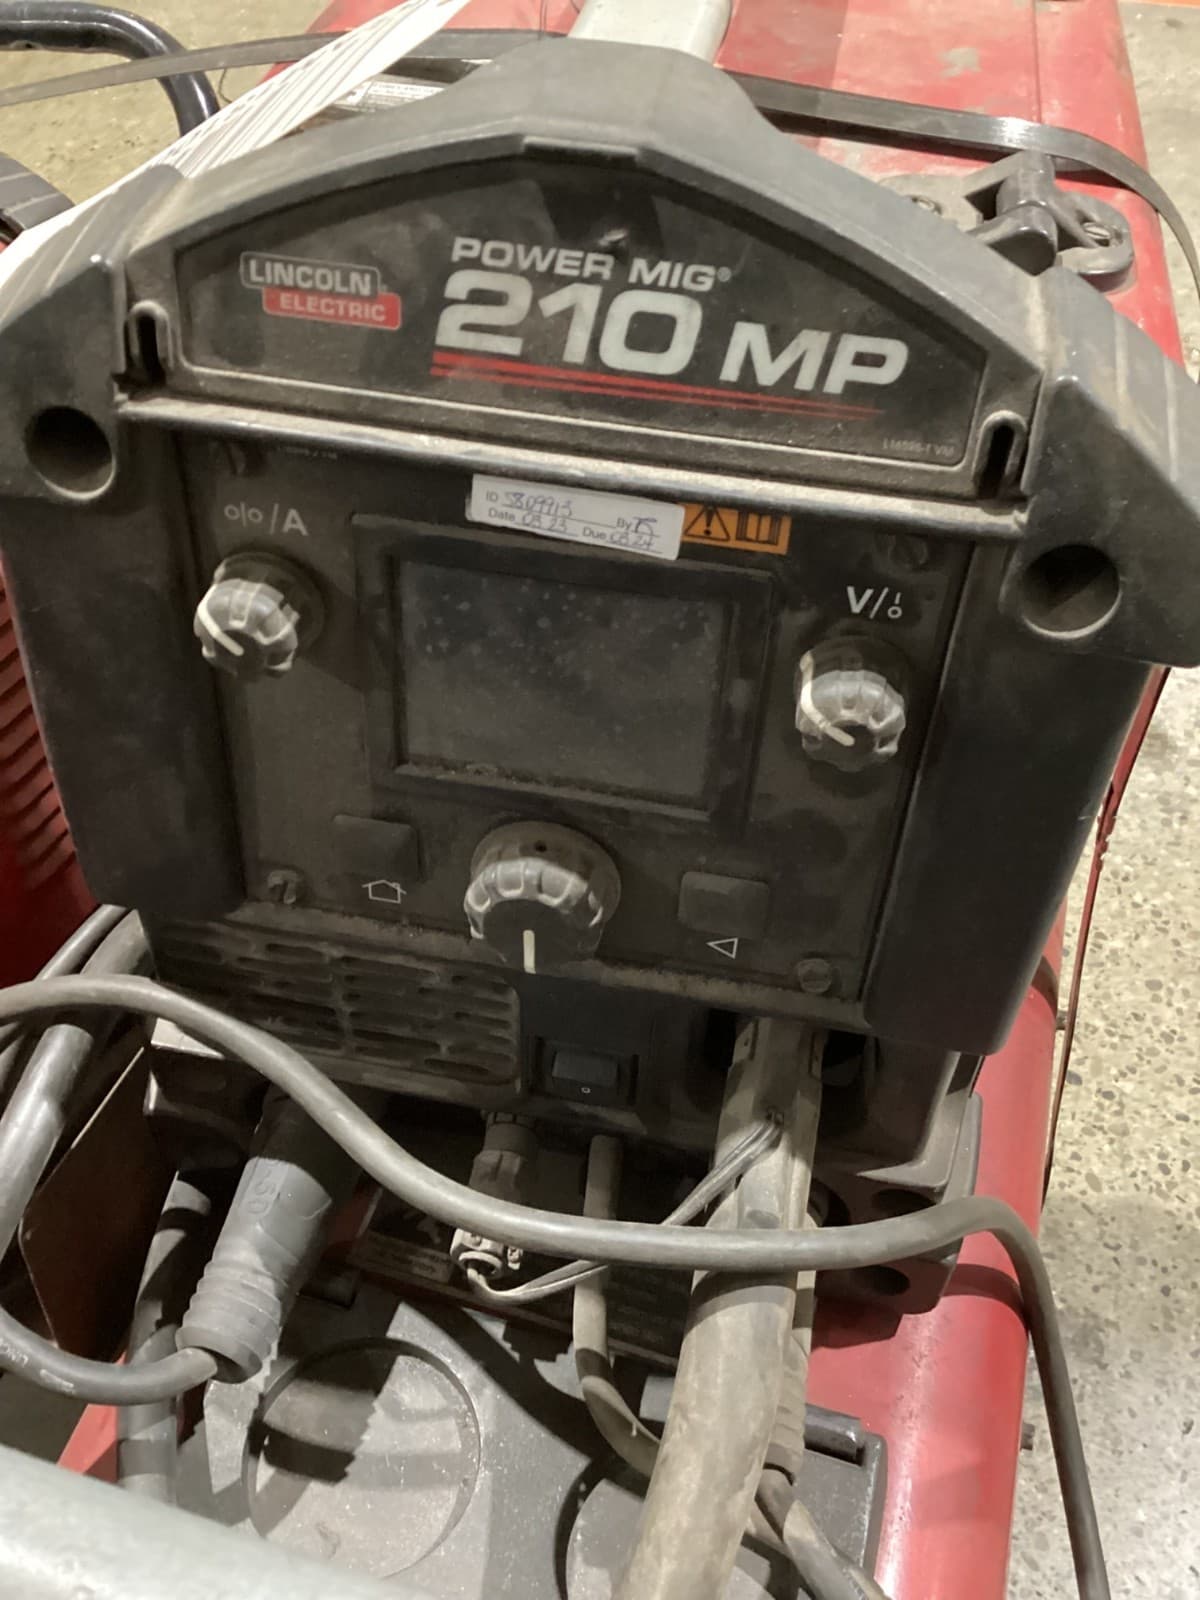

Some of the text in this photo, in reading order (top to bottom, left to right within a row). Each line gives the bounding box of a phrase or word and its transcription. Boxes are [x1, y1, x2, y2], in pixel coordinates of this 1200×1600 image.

[451, 236, 616, 280] POWER
[249, 258, 372, 297] LINCOLN
[279, 291, 387, 322] ELECTRIC
[434, 268, 909, 395] 210 MP
[486, 491, 498, 502] ID
[488, 506, 516, 522] Date
[616, 517, 633, 530] By
[582, 526, 607, 541] Due
